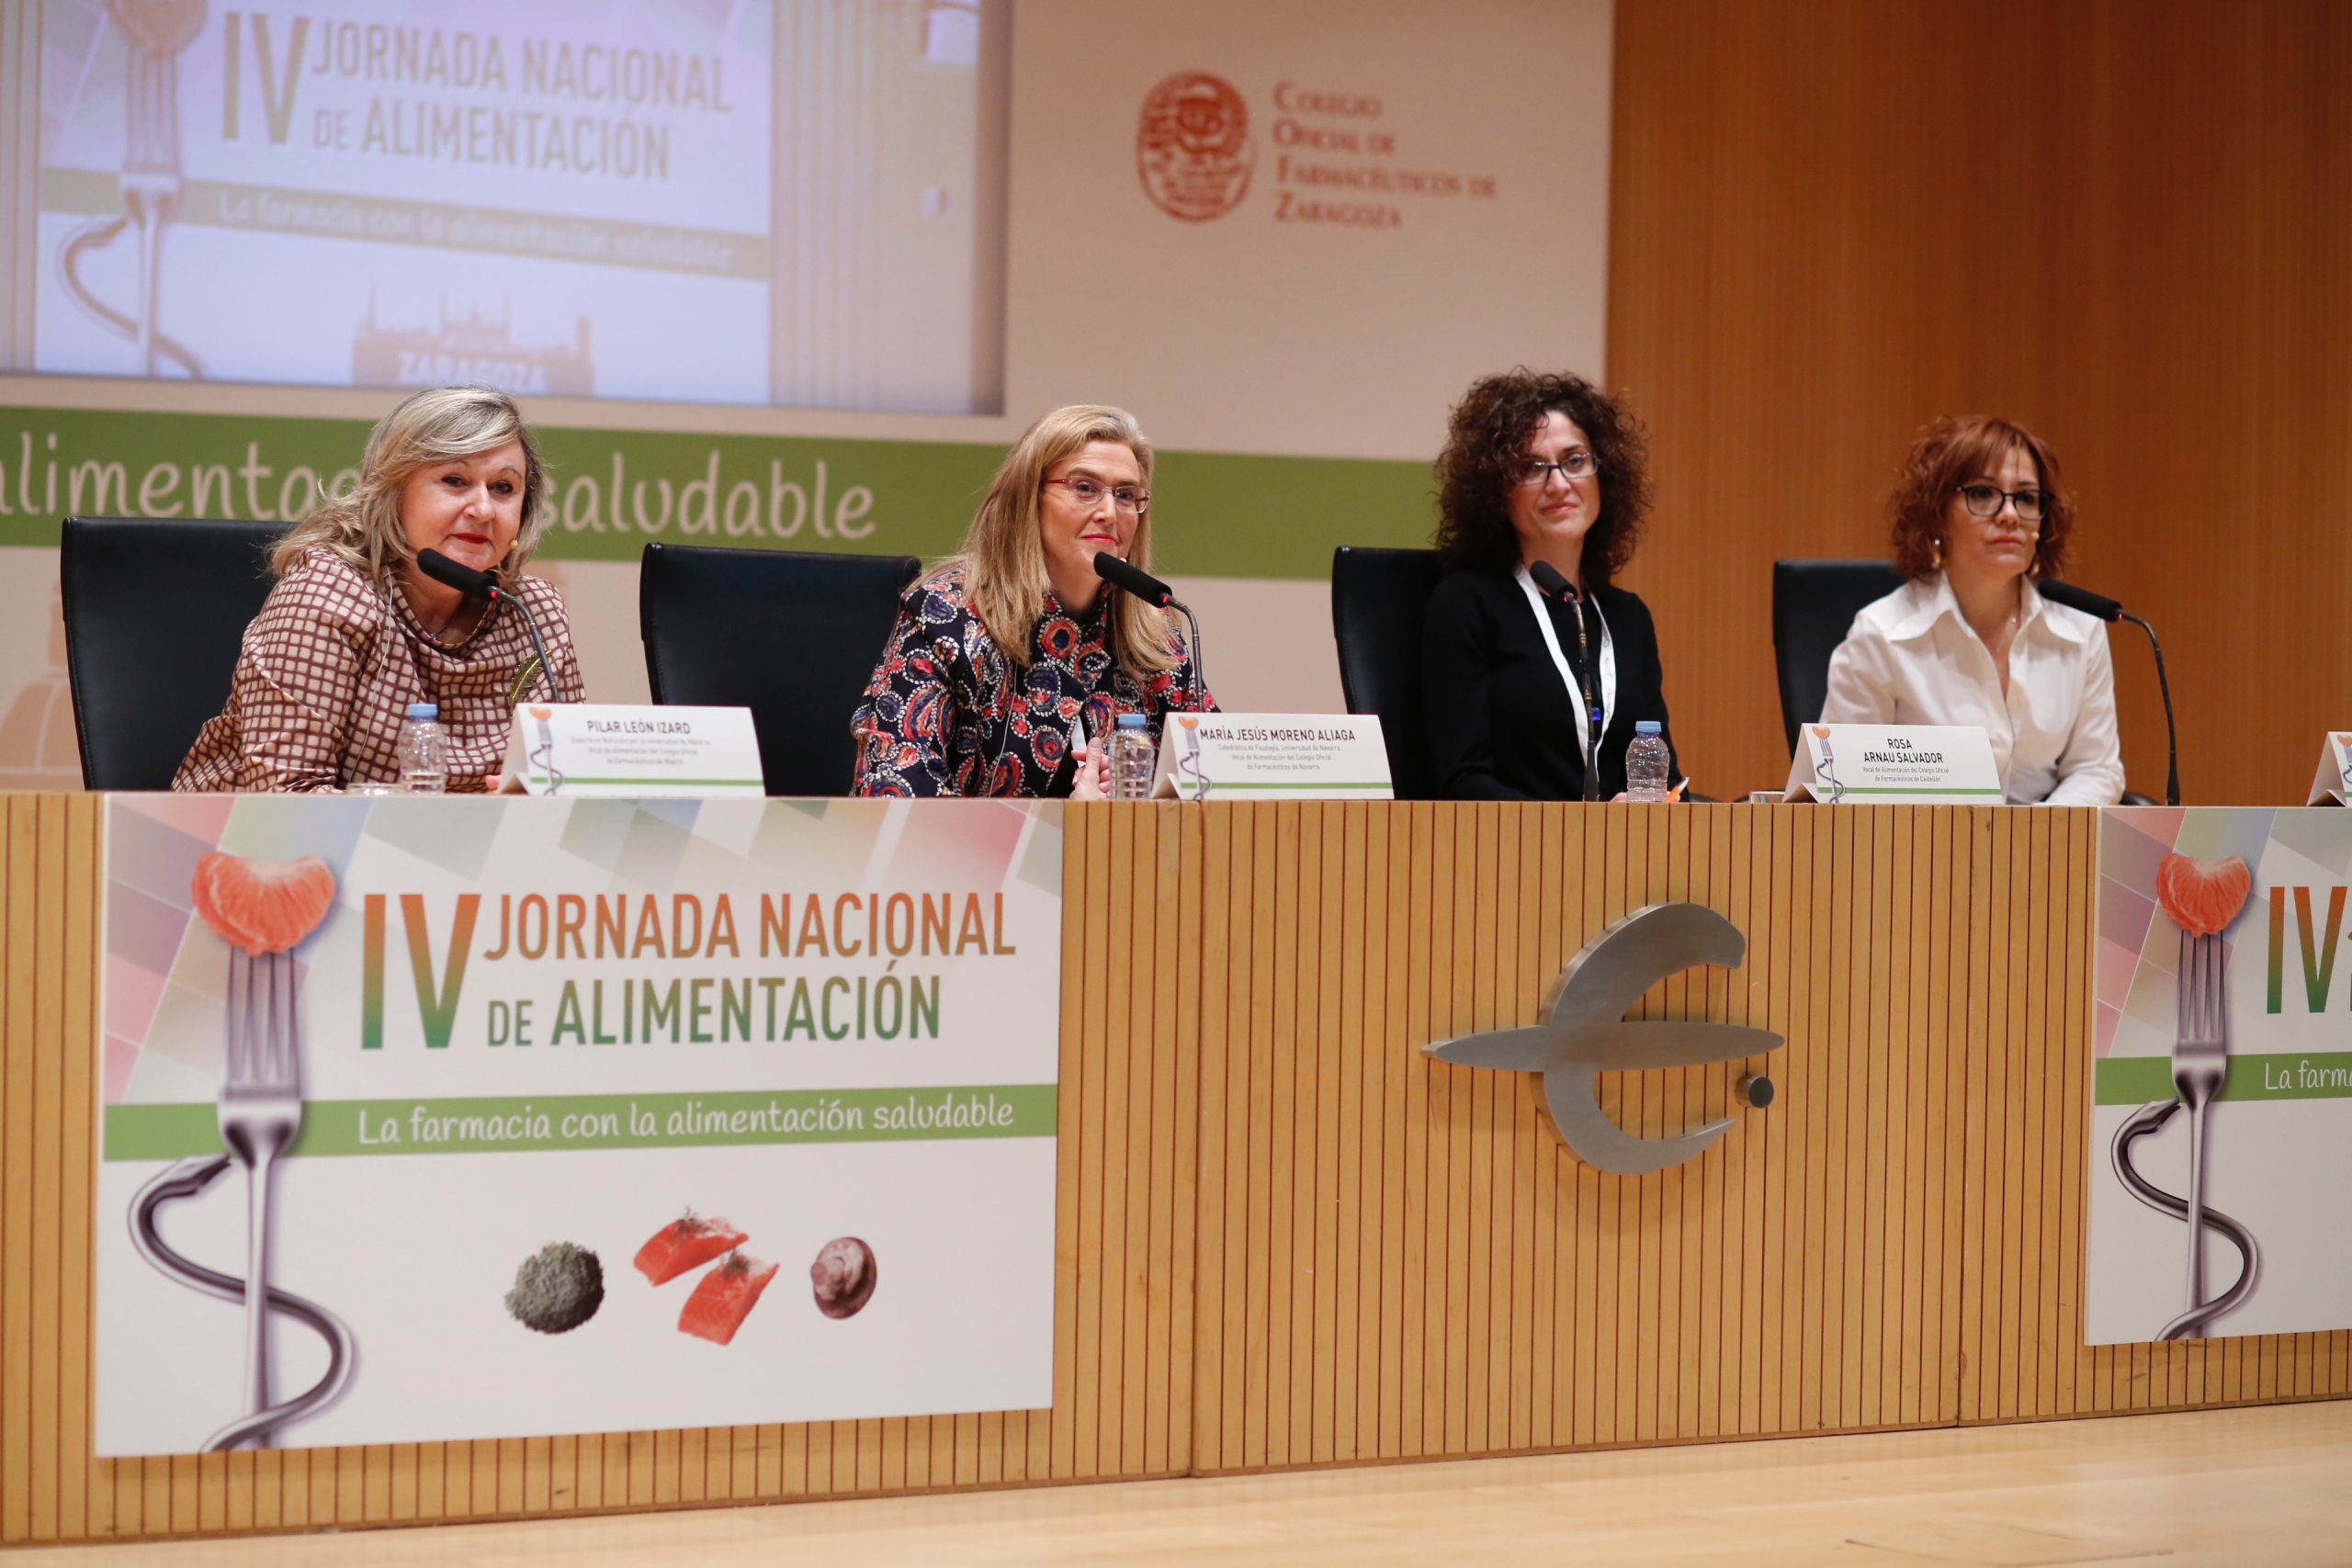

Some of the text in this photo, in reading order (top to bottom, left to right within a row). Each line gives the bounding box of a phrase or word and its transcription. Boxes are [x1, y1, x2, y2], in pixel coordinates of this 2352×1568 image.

[222, 12, 732, 145] IV JORNADA NACIONAL
[314, 98, 671, 181] DE ALIMENTACIÓN
[587, 717, 691, 734] PILAR LEÓN IZARD
[1200, 726, 1356, 741] MARÍA JESÚS MORENO ALIAGA
[1887, 739, 1913, 750] ROSA
[1864, 751, 1944, 763] ARNAU SALVADOR
[360, 892, 1016, 1049] IV JORNADA NACIONAL
[2267, 886, 2347, 1014] IV
[487, 959, 940, 1046] DE ALIMENTACIÓN
[2265, 1062, 2291, 1089] La
[358, 1092, 1014, 1145] La farmacia con la alimentación saludable
